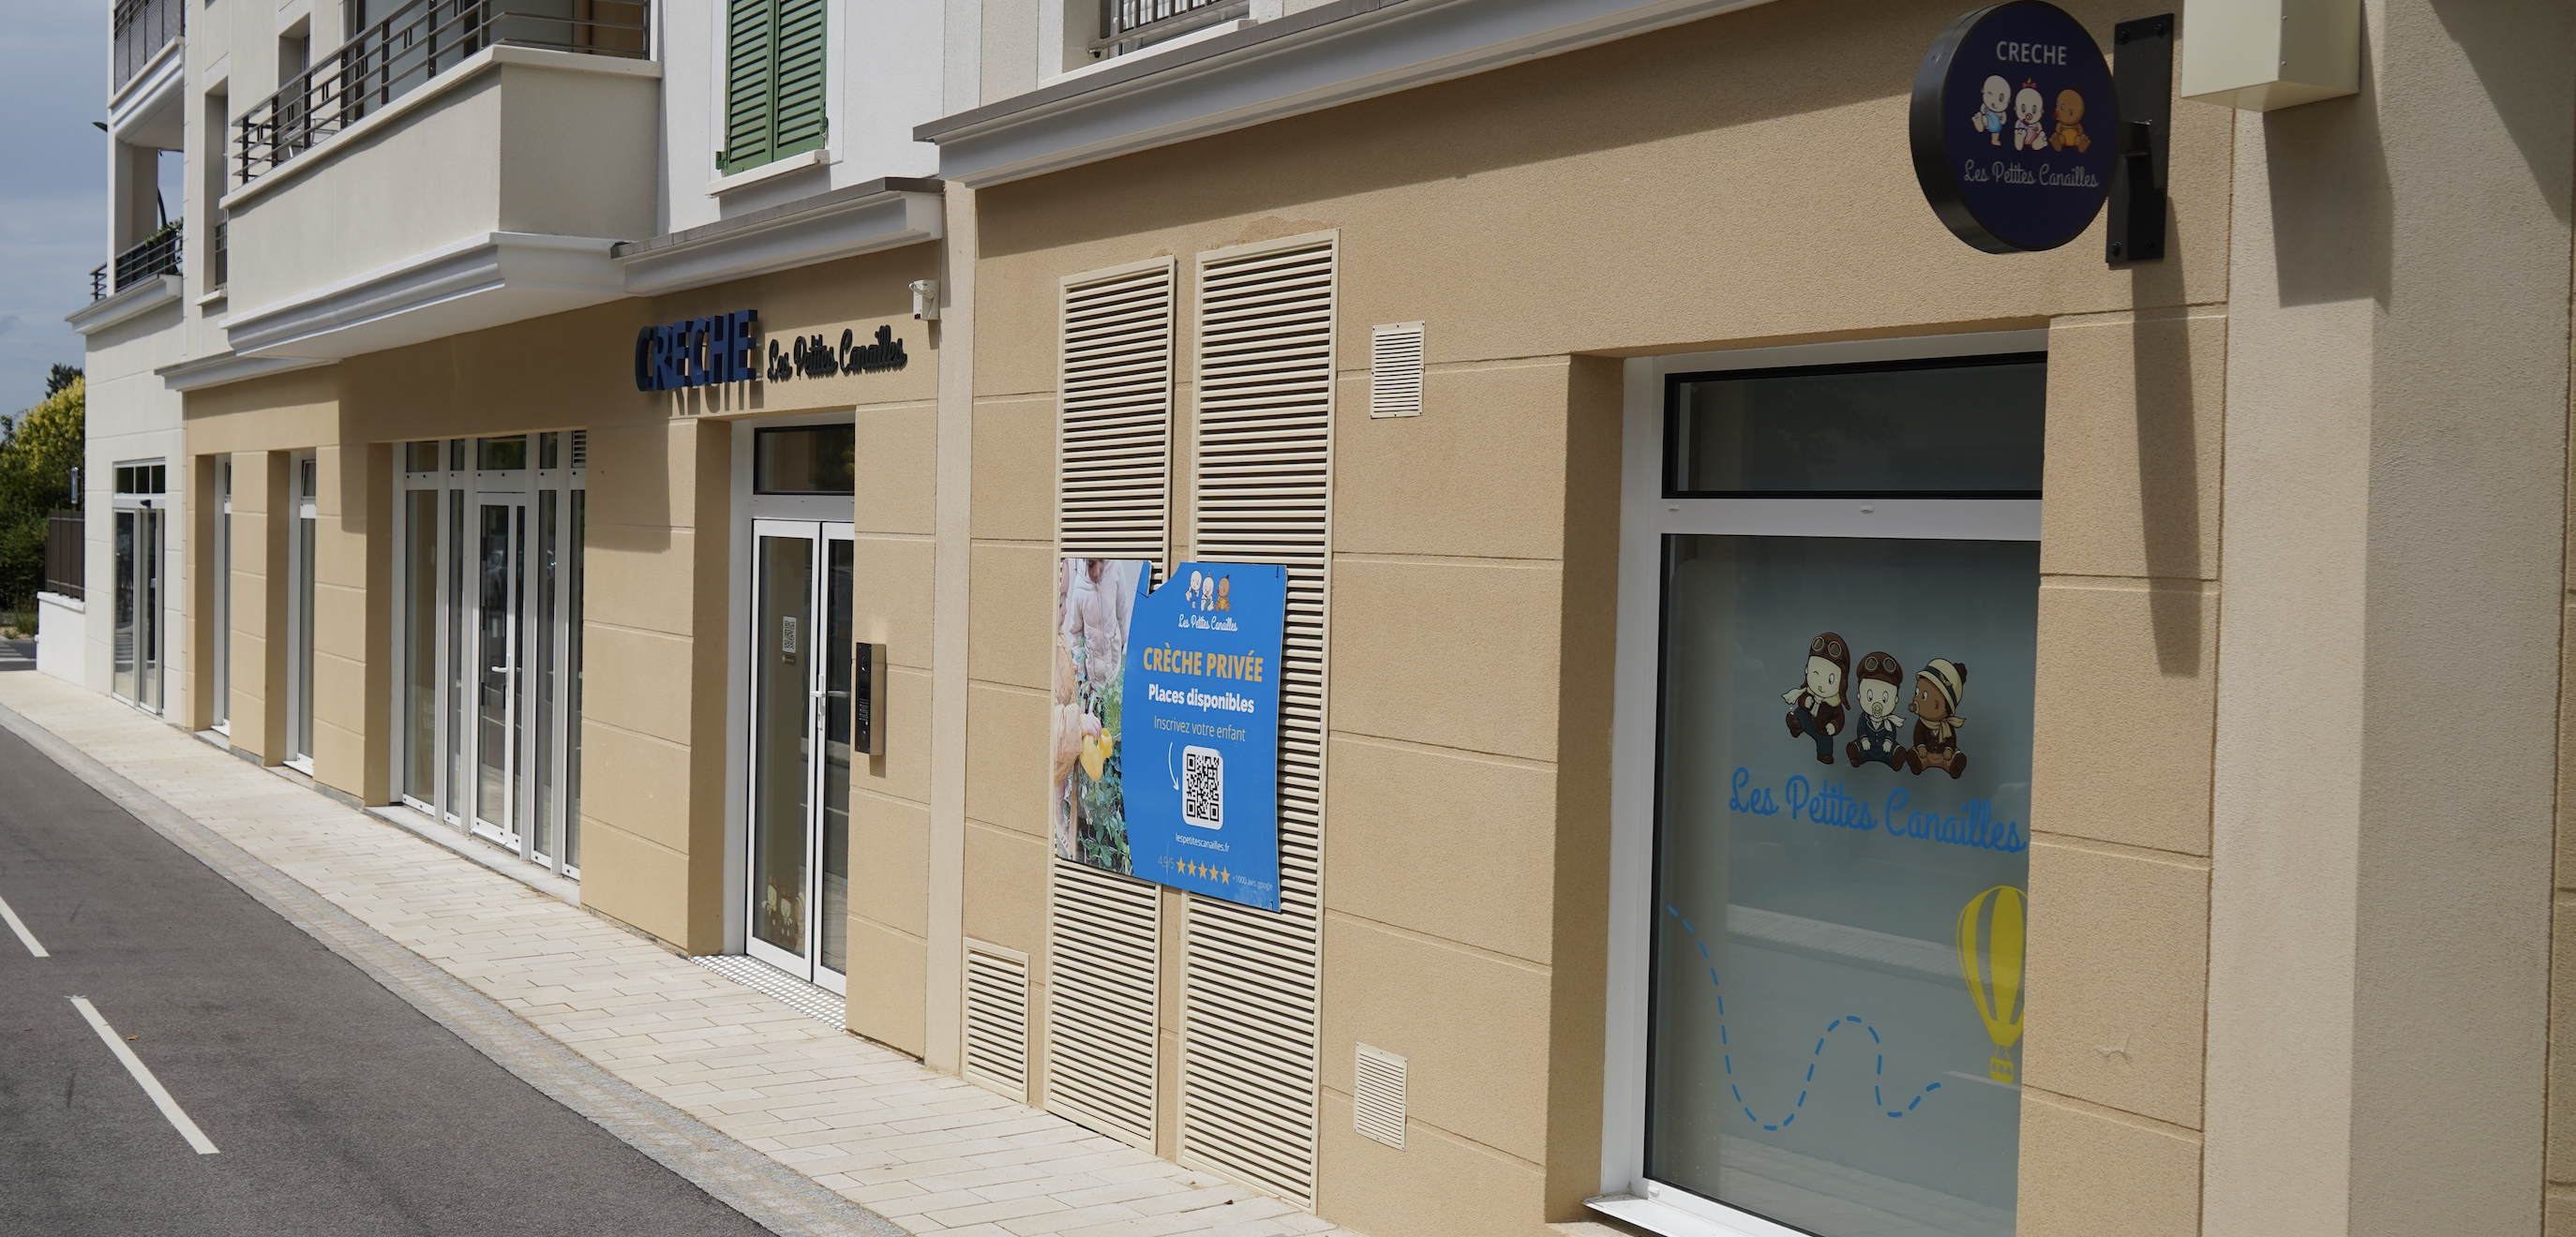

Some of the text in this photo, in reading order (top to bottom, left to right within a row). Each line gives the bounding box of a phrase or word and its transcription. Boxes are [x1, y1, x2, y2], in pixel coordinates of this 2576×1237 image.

[1996, 40, 2067, 66] CRECHE
[1964, 158, 2100, 188] Les Petites Canailles
[635, 309, 908, 392] CRECHE Les Petites Canailles
[1178, 613, 1238, 633] Les Petites Canailles
[1143, 642, 1264, 682] CRÈCHE PRIVÉE
[1148, 683, 1255, 713] Places disponibles
[1153, 714, 1246, 742] Inscrivez votre enfant
[1729, 767, 2028, 854] Les Petites Canailles
[1175, 832, 1231, 853] lespetitescanailles.fr
[1232, 874, 1274, 892] +1000 avis google
